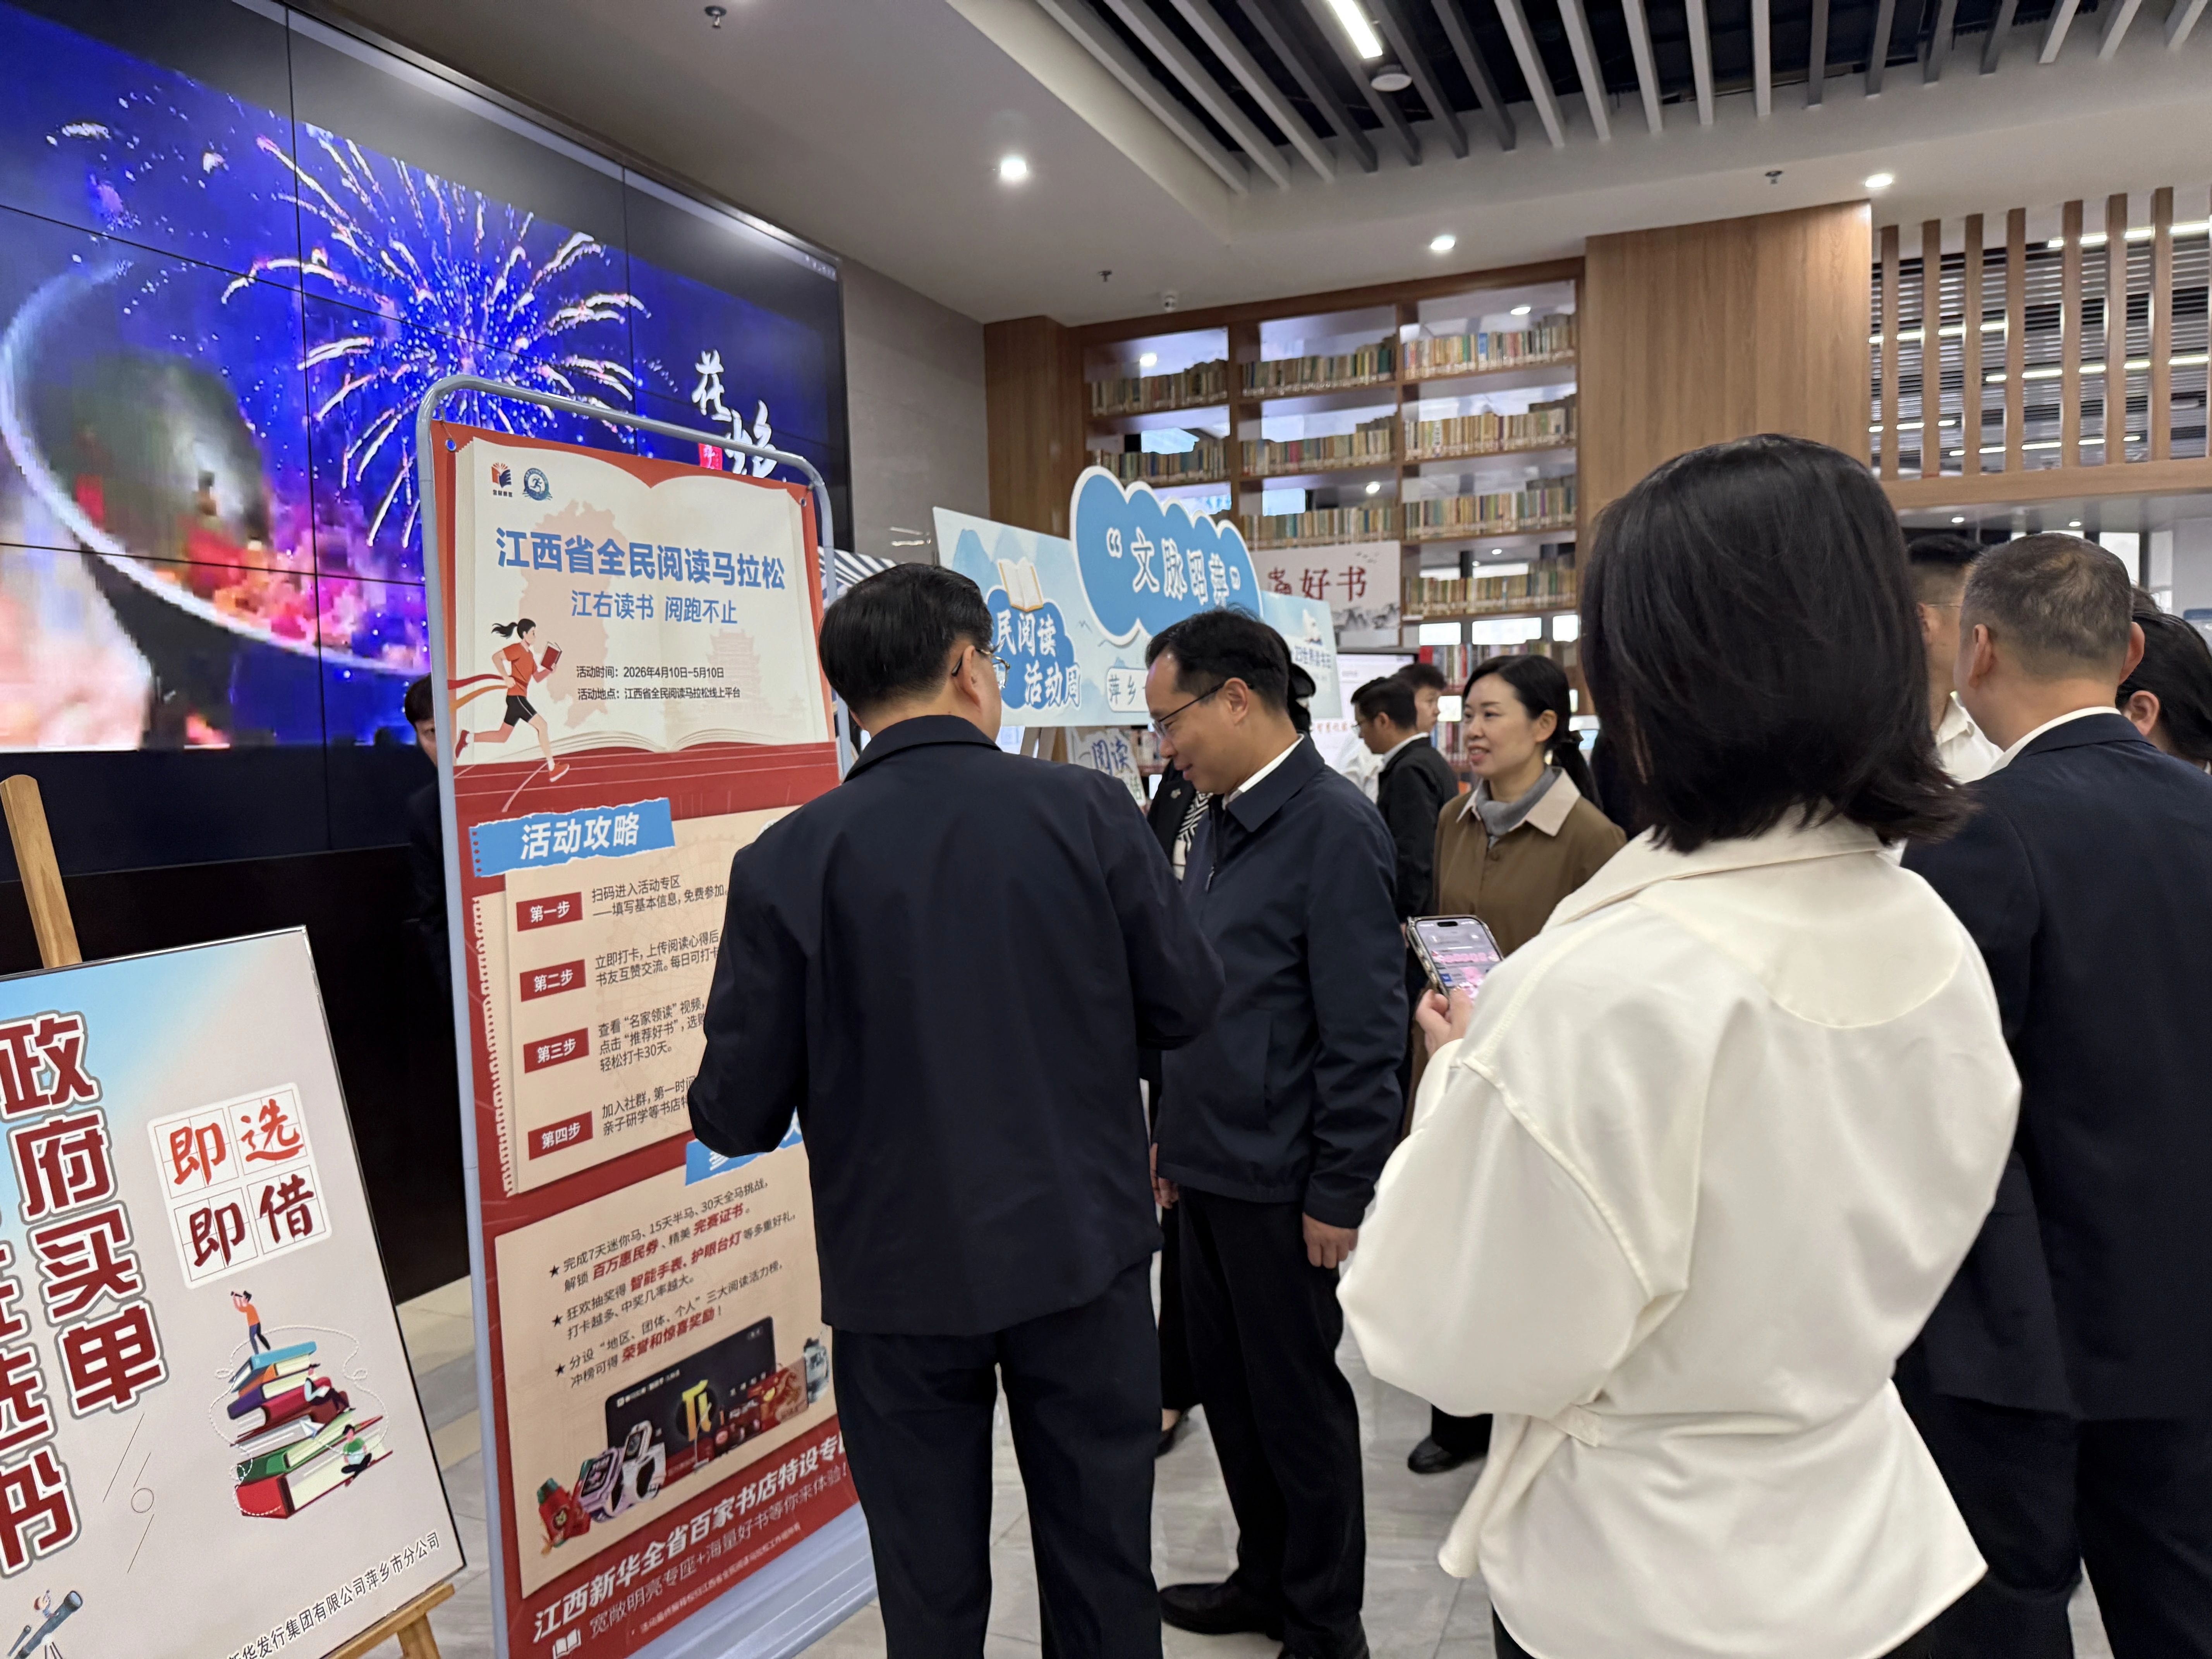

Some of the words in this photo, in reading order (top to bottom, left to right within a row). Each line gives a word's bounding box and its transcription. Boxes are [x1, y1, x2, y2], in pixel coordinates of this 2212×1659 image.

[496, 527, 785, 589] 江西省全民阅读马拉松
[571, 590, 654, 620] 江右读书
[665, 596, 738, 624] 阅跑不止
[1025, 659, 1080, 708] 活动周
[520, 812, 639, 860] 活动攻略
[592, 874, 681, 903] 扫码进入活动专区
[530, 900, 570, 923] 第一步
[595, 929, 719, 970] 立即打卡，上传阅读心得后
[534, 969, 573, 993] 第二步
[537, 1038, 576, 1063] 第三步
[600, 1040, 672, 1072] 轻松打卡30天。
[170, 1098, 304, 1185] 即选
[542, 1122, 580, 1150] 第四步
[0, 1015, 163, 1413] 政府买单
[189, 1173, 314, 1267] 即借
[565, 1271, 588, 1293] 解锁
[593, 1238, 659, 1280] 百万惠民券
[567, 1282, 627, 1321] 狂欢抽奖得
[229, 1532, 440, 1659] 华发行集团有限公司萍乡市分公司
